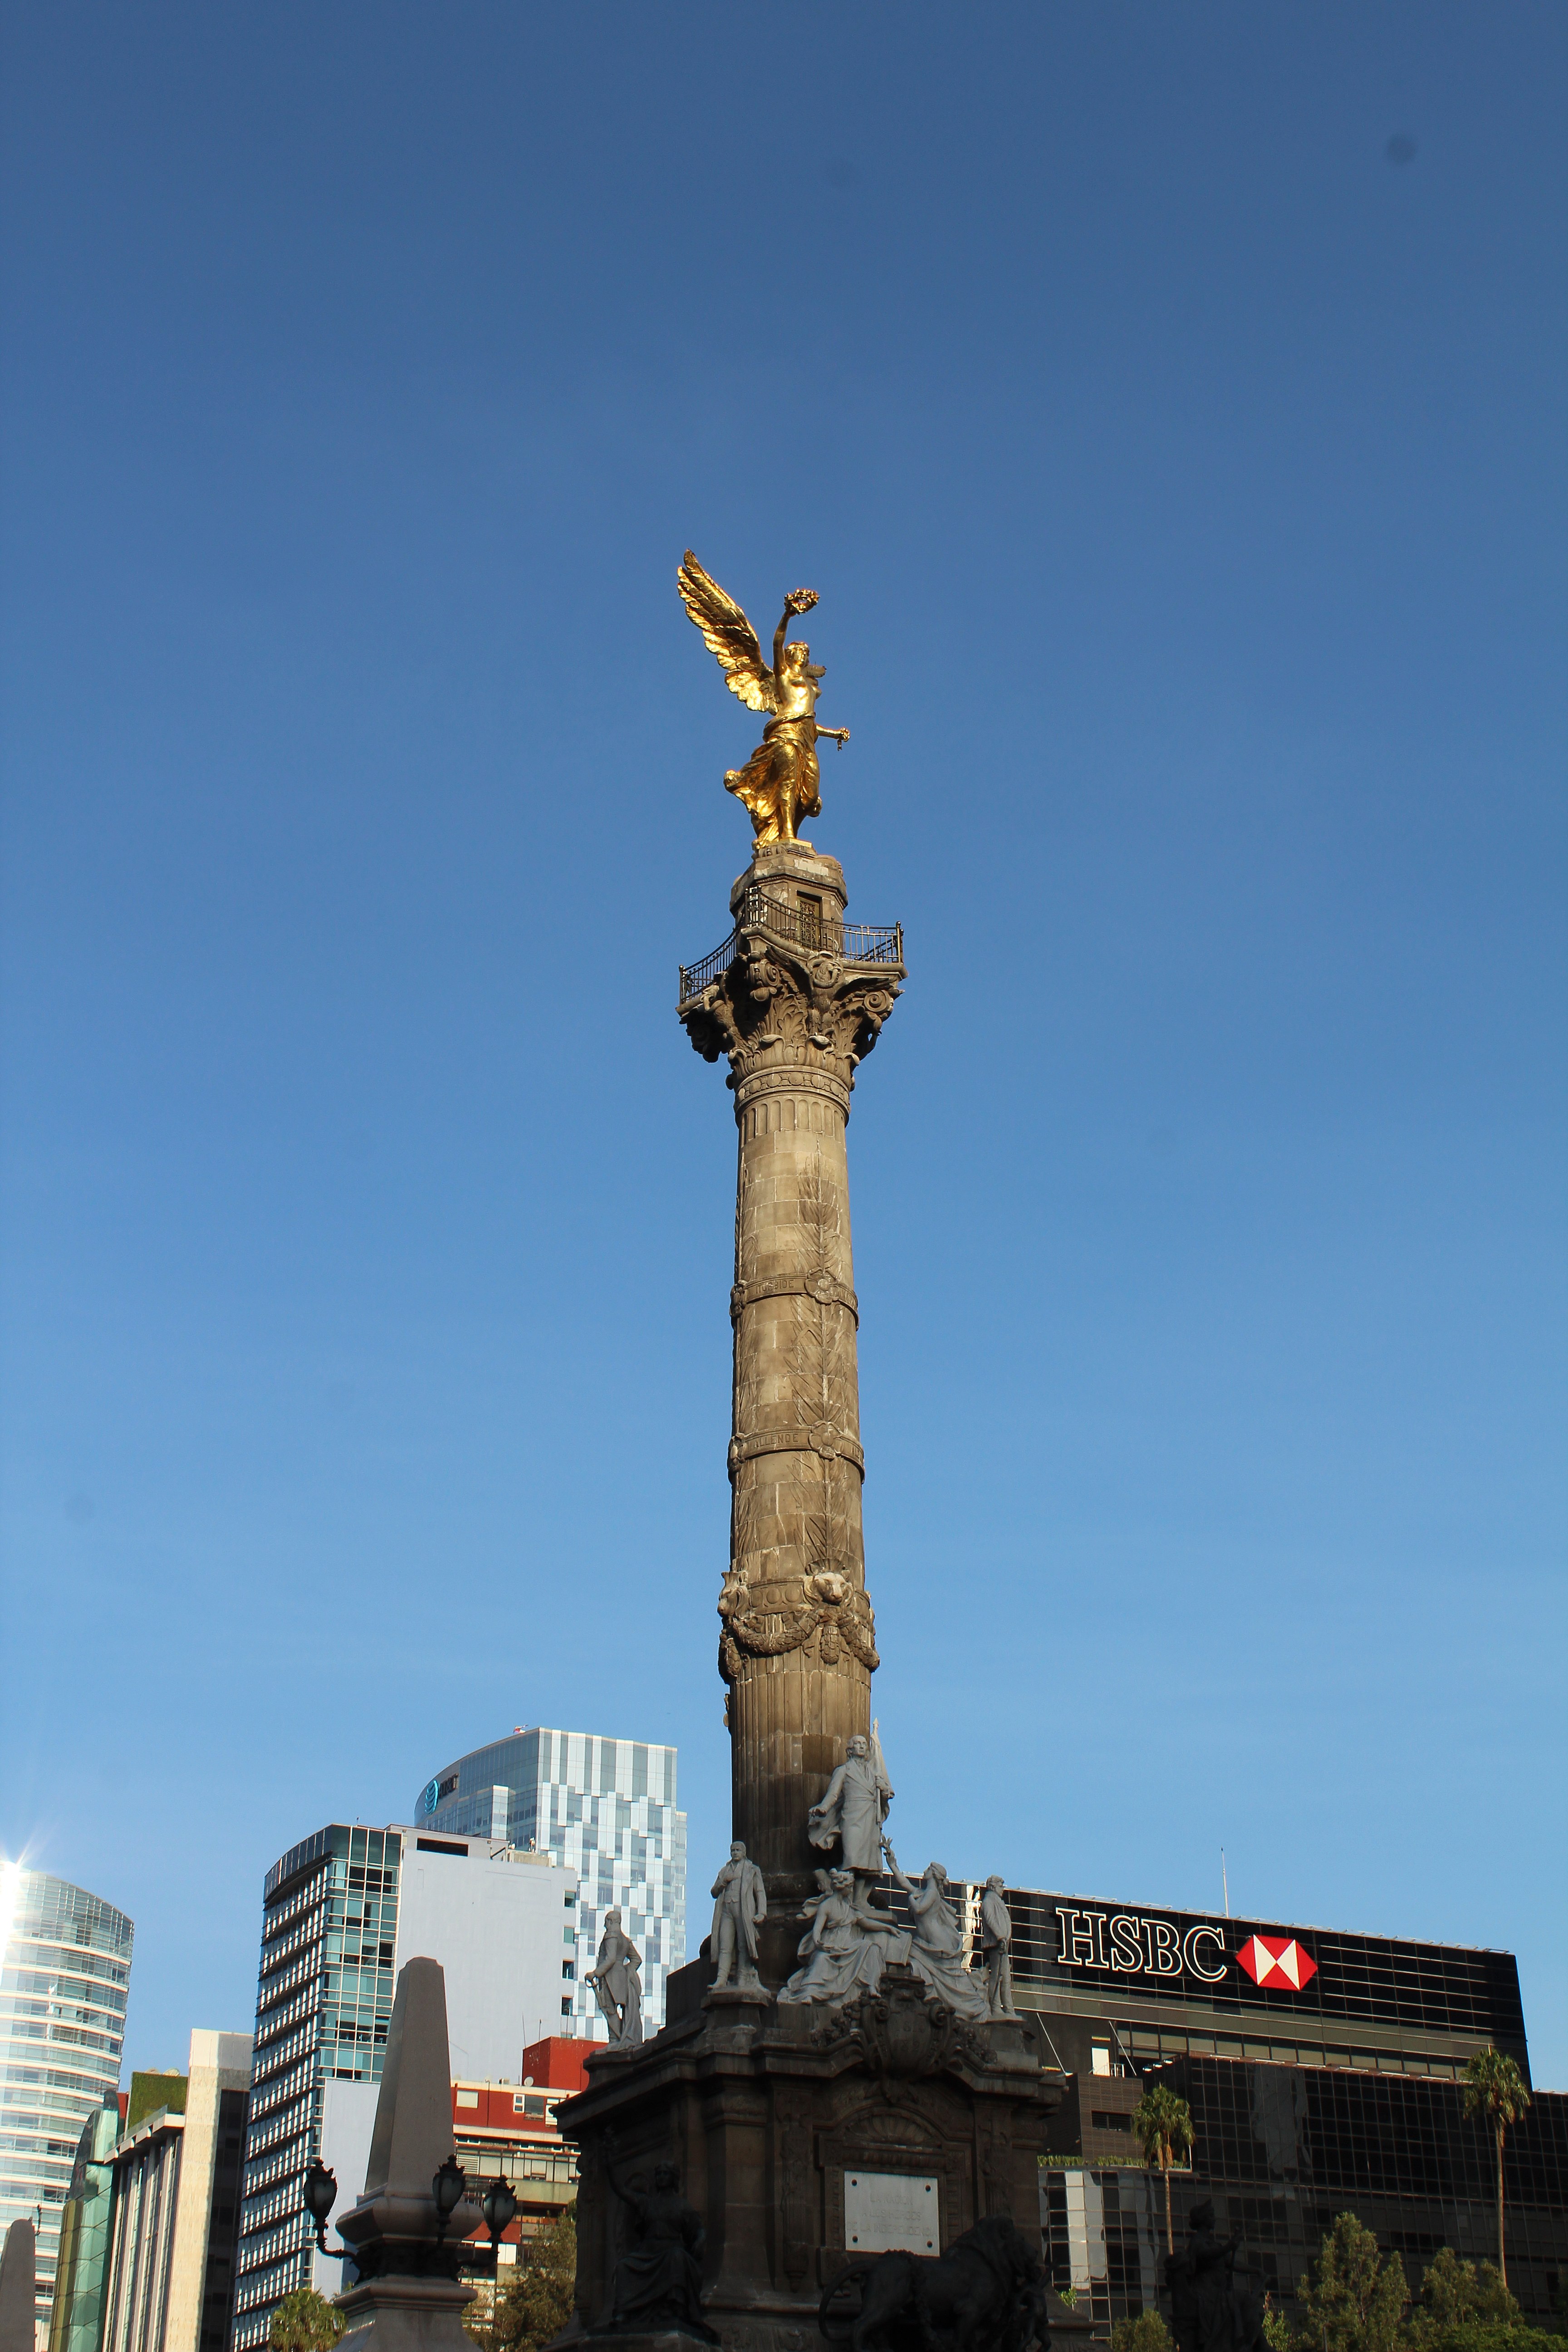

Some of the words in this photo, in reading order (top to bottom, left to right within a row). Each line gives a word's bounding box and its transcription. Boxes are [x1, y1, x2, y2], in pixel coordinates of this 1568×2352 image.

[755, 1279, 794, 1294] ITURBIDE
[754, 1434, 799, 1448] ALLENDE
[1055, 1906, 1228, 1982] HSBC
